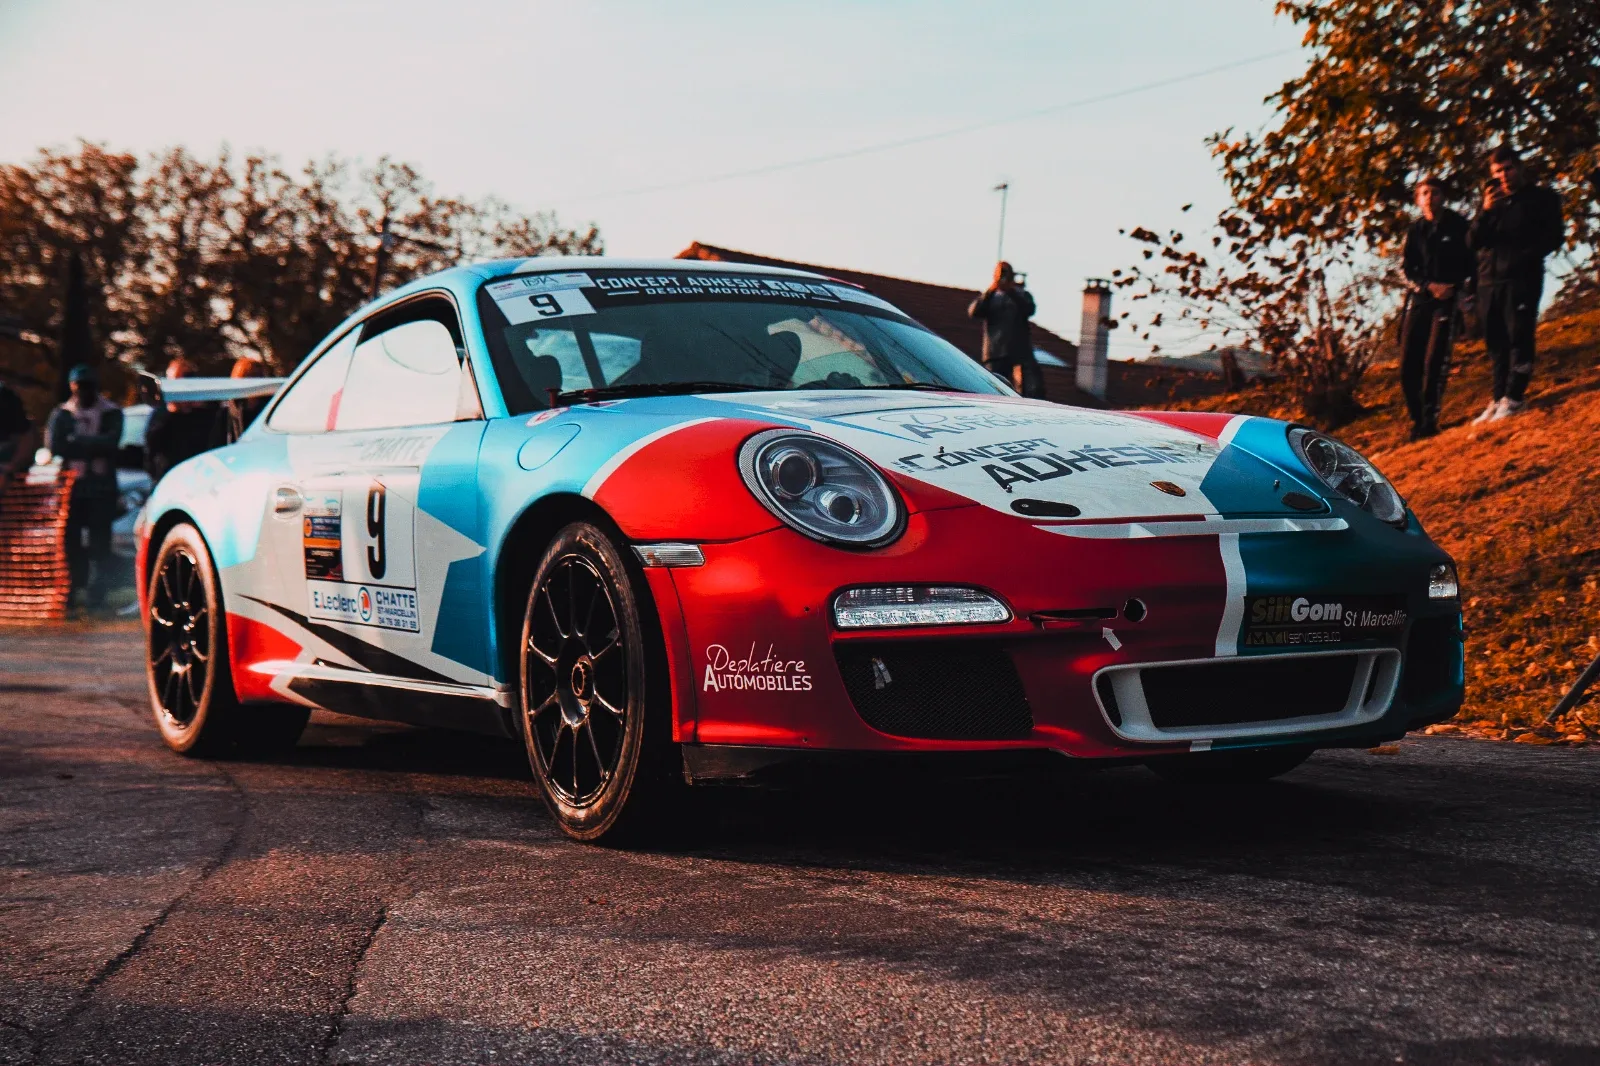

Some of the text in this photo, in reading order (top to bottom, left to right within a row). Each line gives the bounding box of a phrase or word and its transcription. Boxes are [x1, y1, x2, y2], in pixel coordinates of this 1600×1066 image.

[596, 276, 760, 289] CONCEPT ADHESIF
[645, 287, 807, 299] DESIGN MOTORSPORT
[529, 293, 564, 316] 9
[897, 438, 1059, 471] CONCEPT
[367, 486, 386, 580] 9
[313, 591, 357, 613] E.Leclerc
[375, 591, 415, 609] CHATTE
[1251, 596, 1407, 627] SiliGom St Marcellin
[706, 641, 806, 675] Deplatiere
